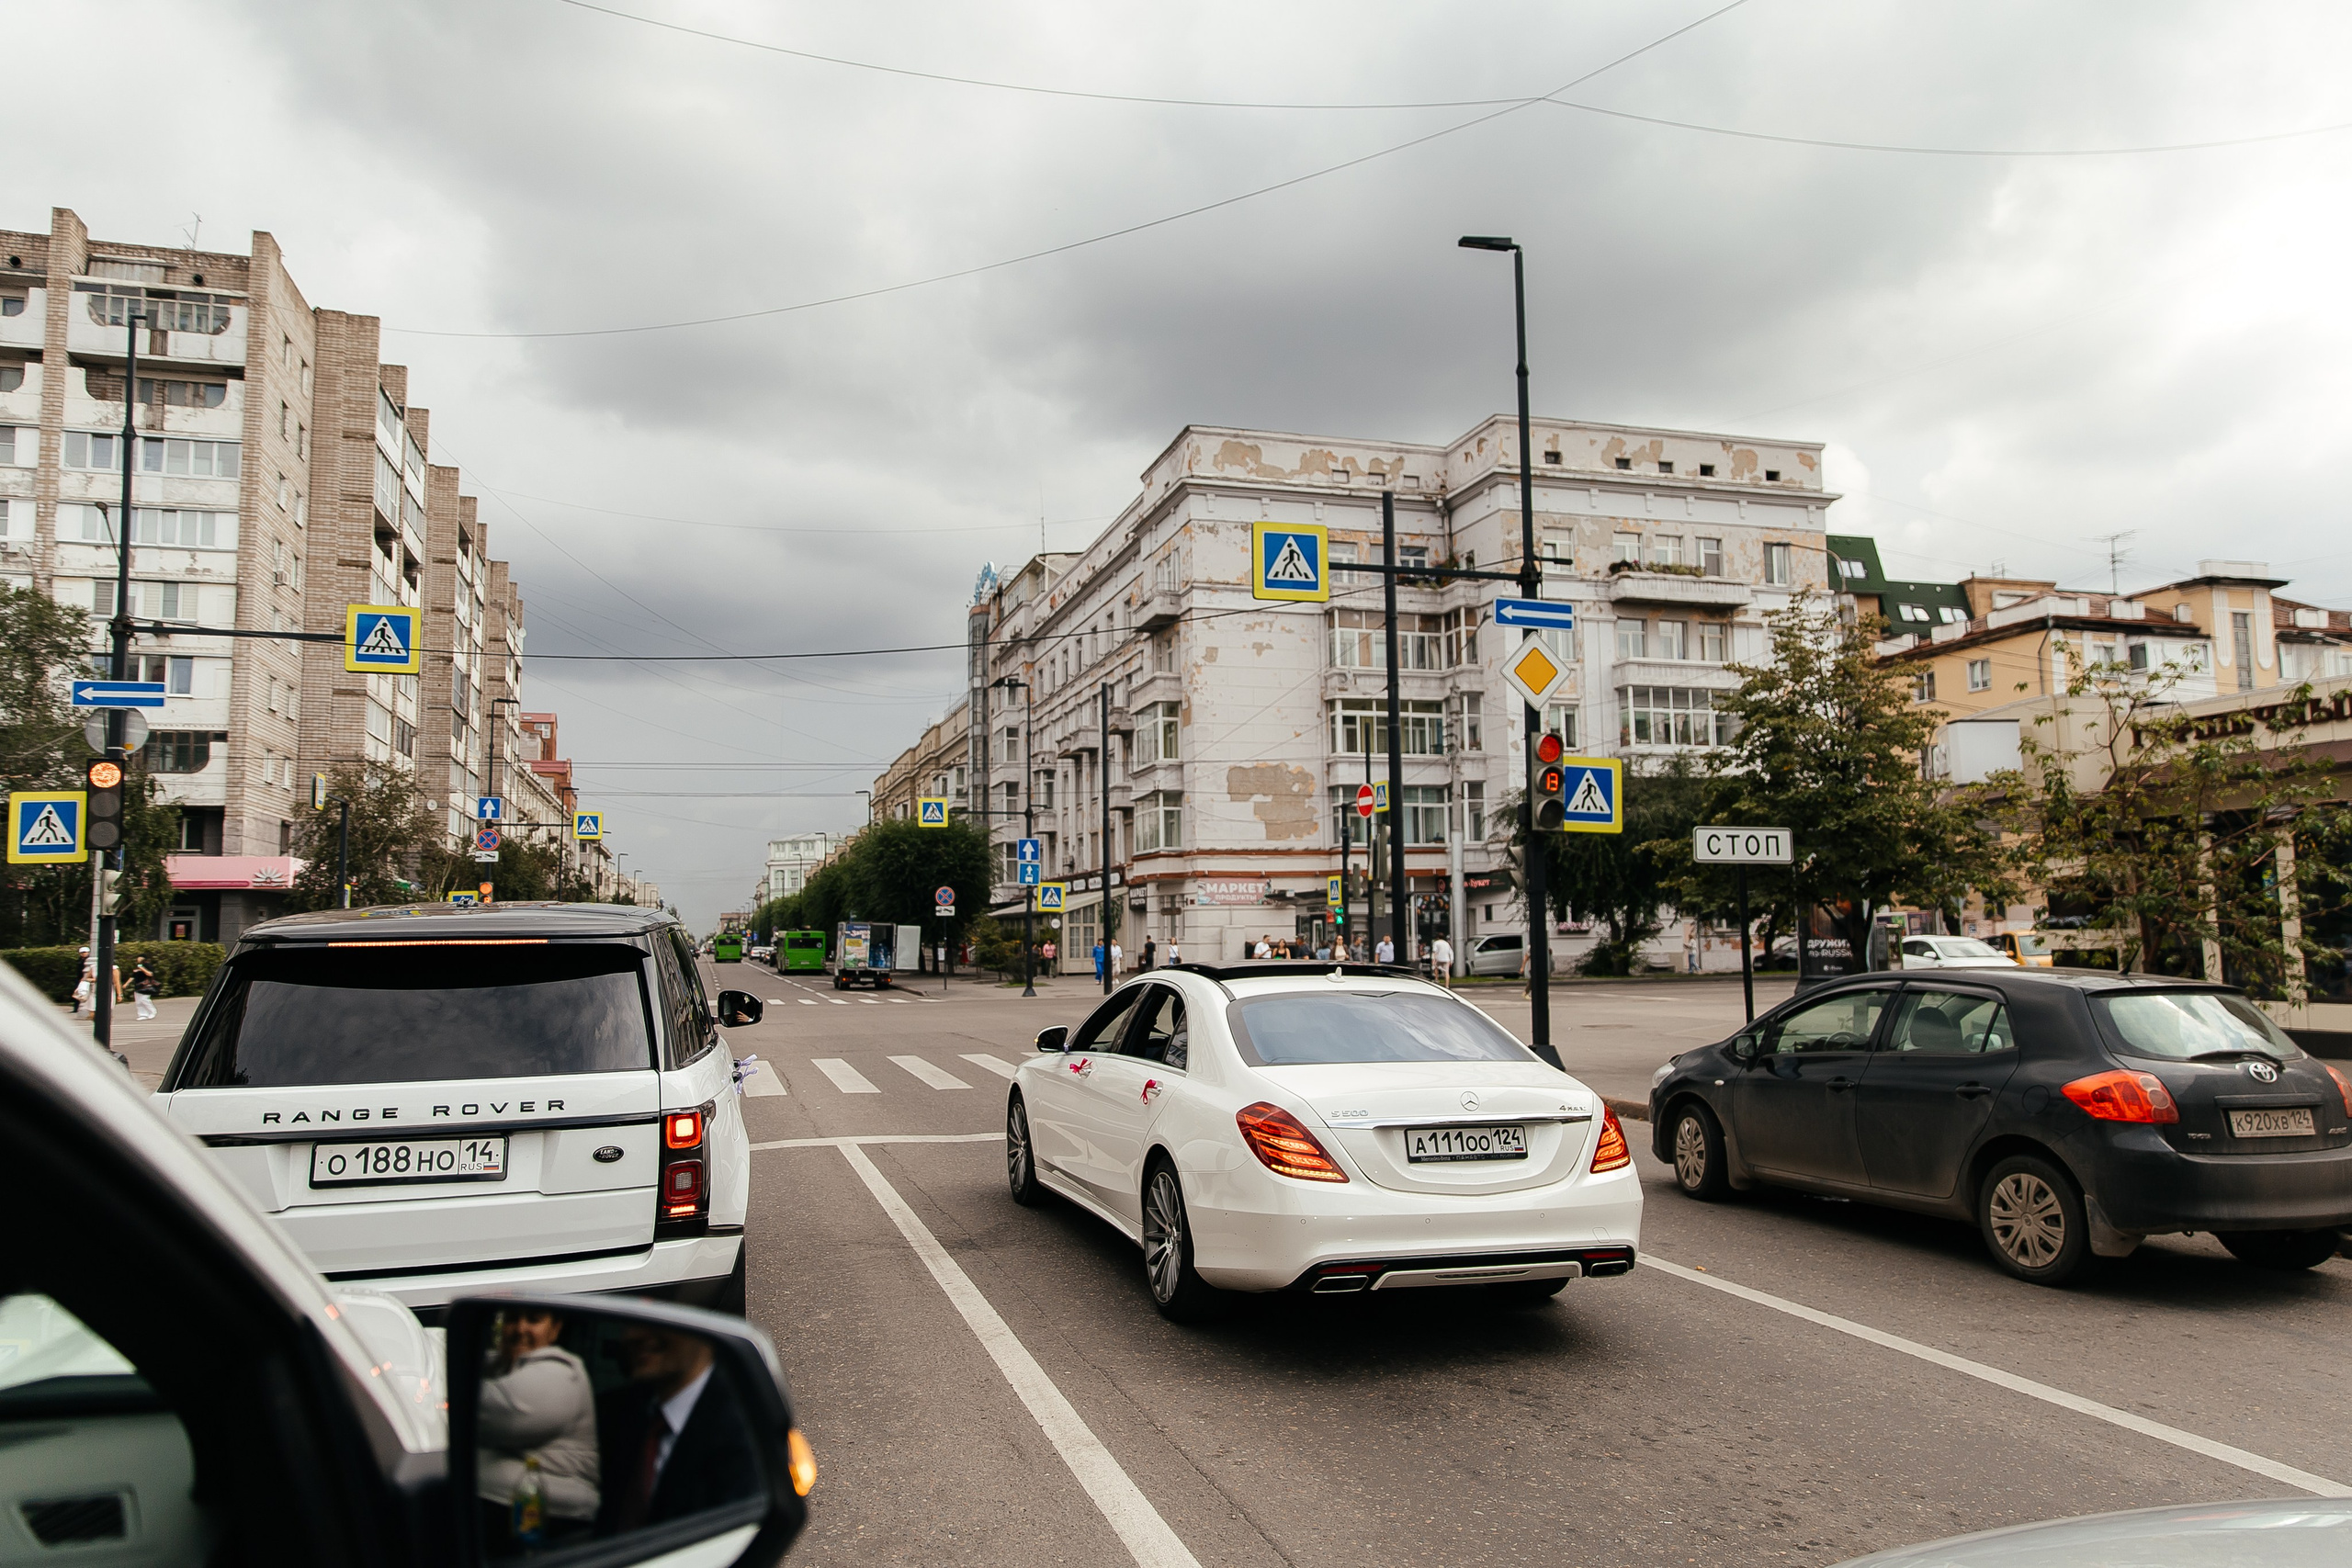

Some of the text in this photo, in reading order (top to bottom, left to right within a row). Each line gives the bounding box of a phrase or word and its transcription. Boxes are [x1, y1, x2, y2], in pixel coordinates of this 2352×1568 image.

[1545, 772, 1559, 792] 13
[1706, 833, 1781, 856] СТОП
[1205, 882, 1265, 893] МАРКЕТ
[263, 1099, 566, 1125] RANGE ROVER
[2290, 1110, 2311, 1125] 124
[1492, 1128, 1521, 1145] 124
[465, 1141, 496, 1164] 14
[460, 1162, 483, 1172] RUS
